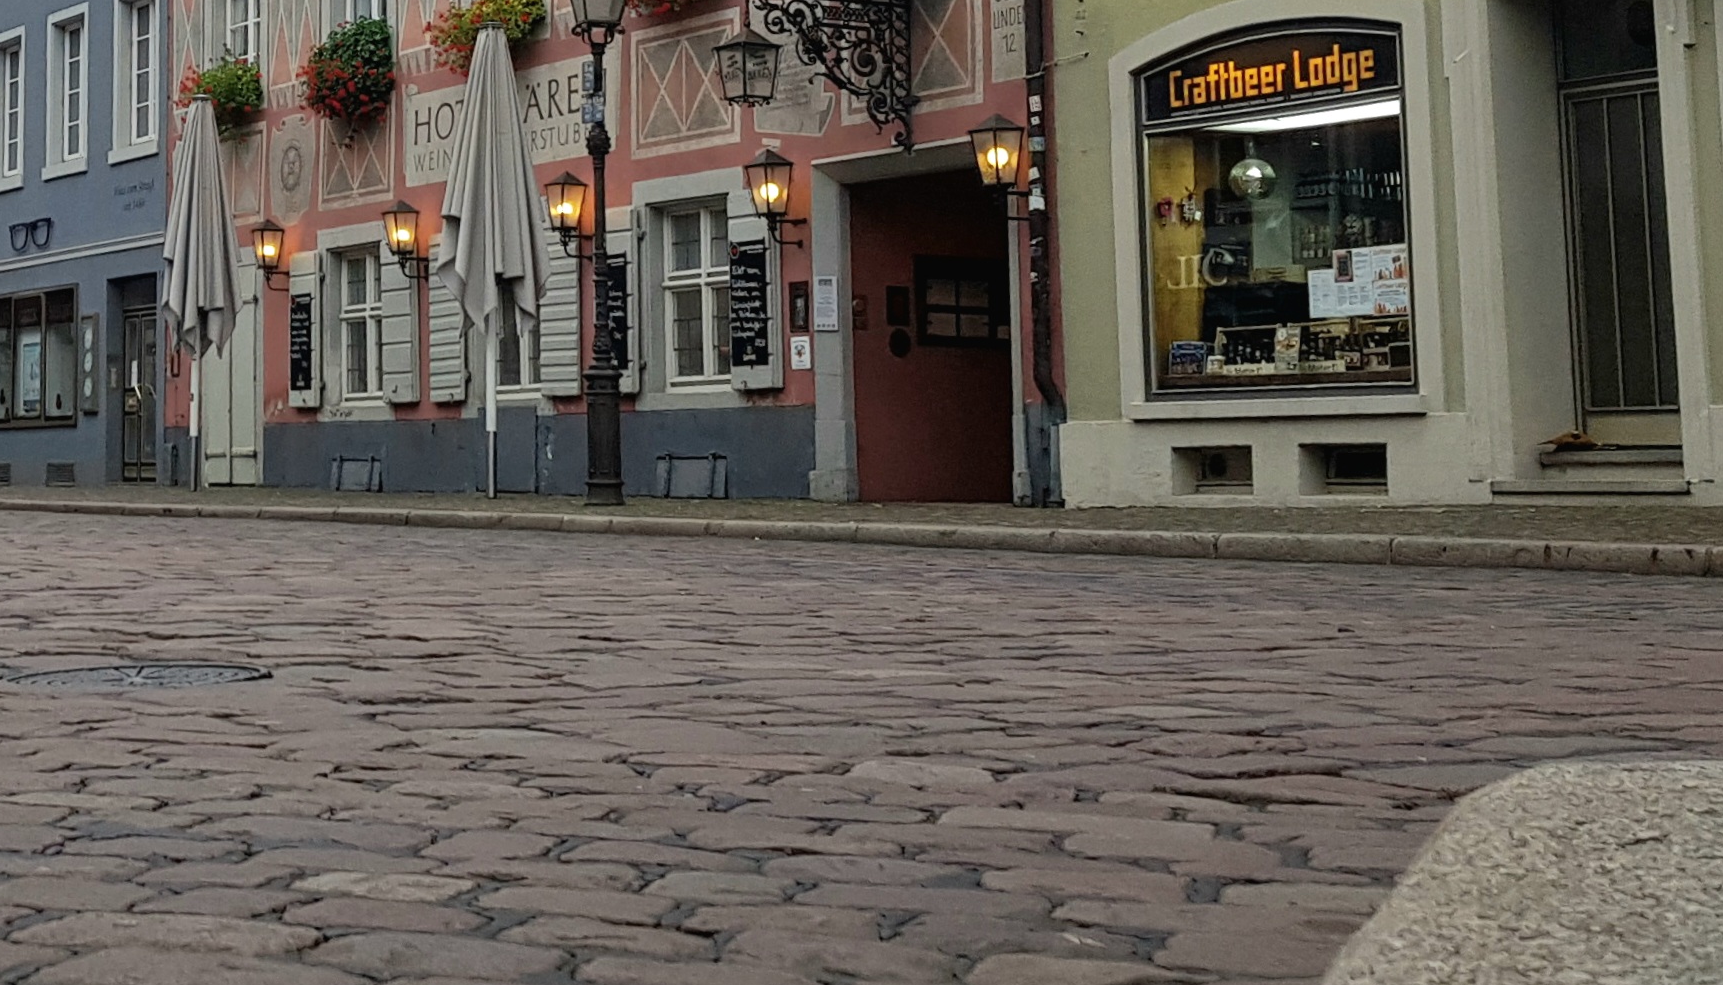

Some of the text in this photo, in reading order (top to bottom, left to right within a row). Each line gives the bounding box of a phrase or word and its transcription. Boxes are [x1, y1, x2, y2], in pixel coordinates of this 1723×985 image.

[993, 5, 1023, 30] LINDE
[1002, 32, 1017, 53] 12
[1169, 61, 1287, 108] Craftbeer
[1292, 44, 1375, 92] Lodge
